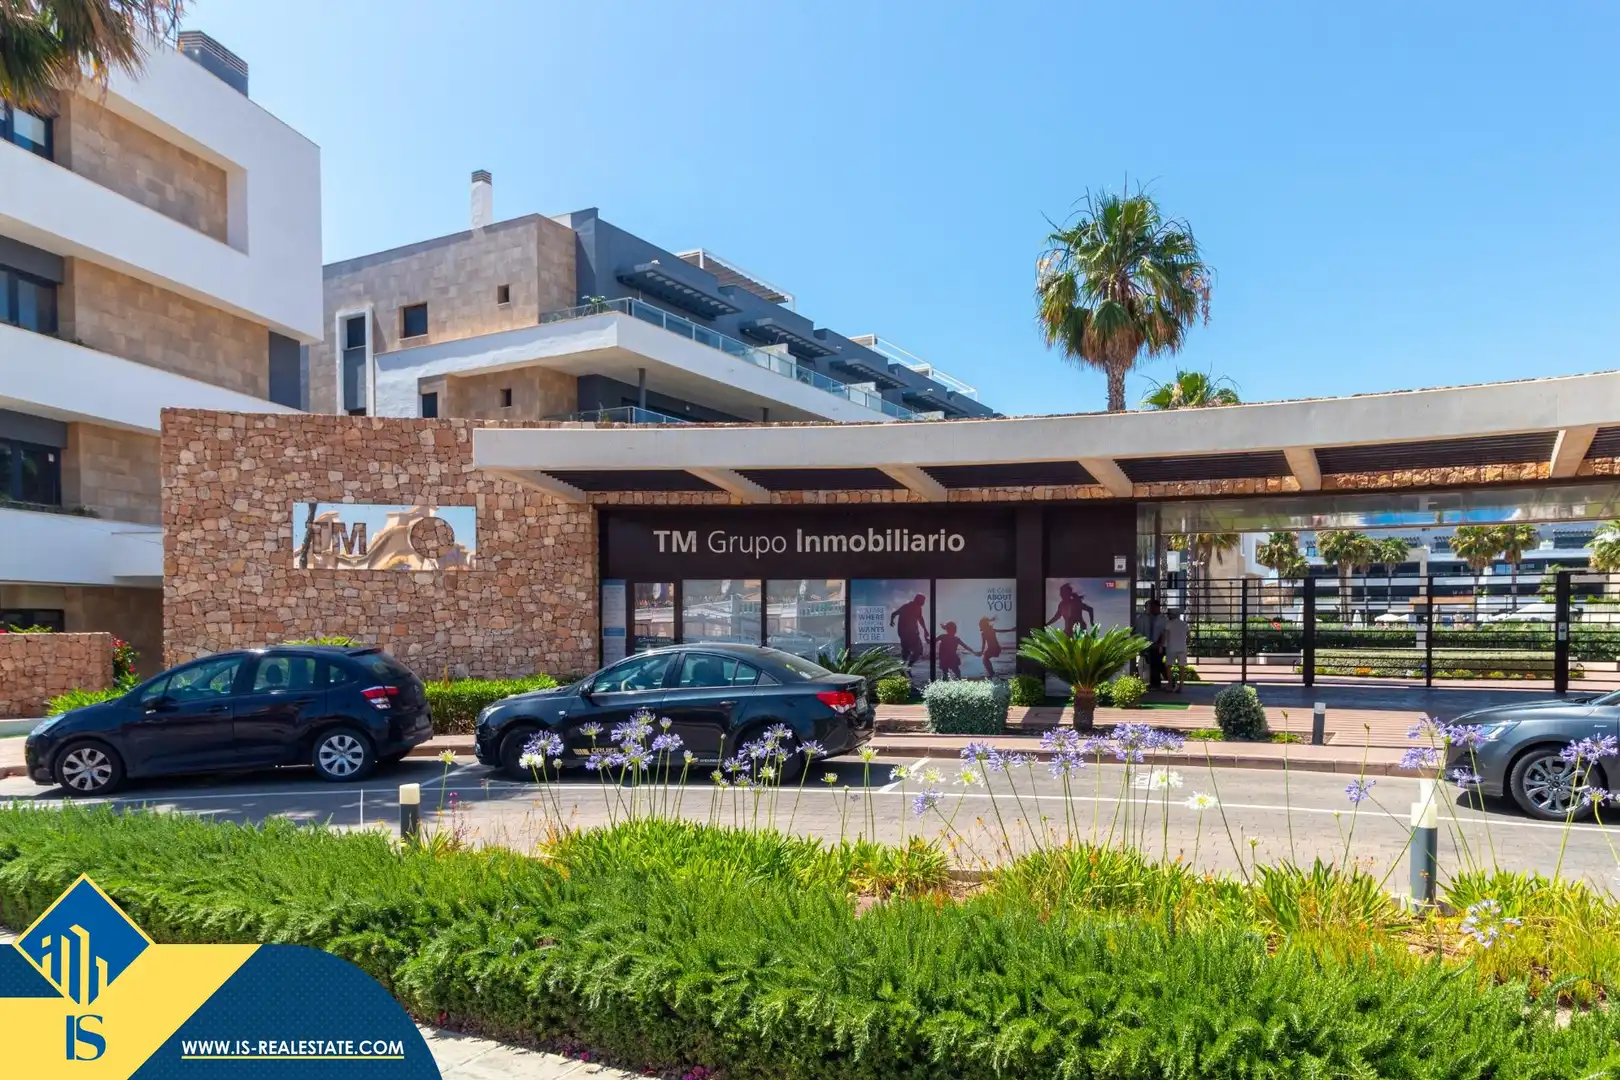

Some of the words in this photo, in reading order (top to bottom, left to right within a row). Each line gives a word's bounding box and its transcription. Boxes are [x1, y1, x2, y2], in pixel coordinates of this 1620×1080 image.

[653, 530, 697, 553] TM
[707, 530, 787, 559] Grupo
[796, 528, 965, 552] Inmobiliario
[987, 601, 1013, 612] YOU
[858, 633, 869, 641] TO
